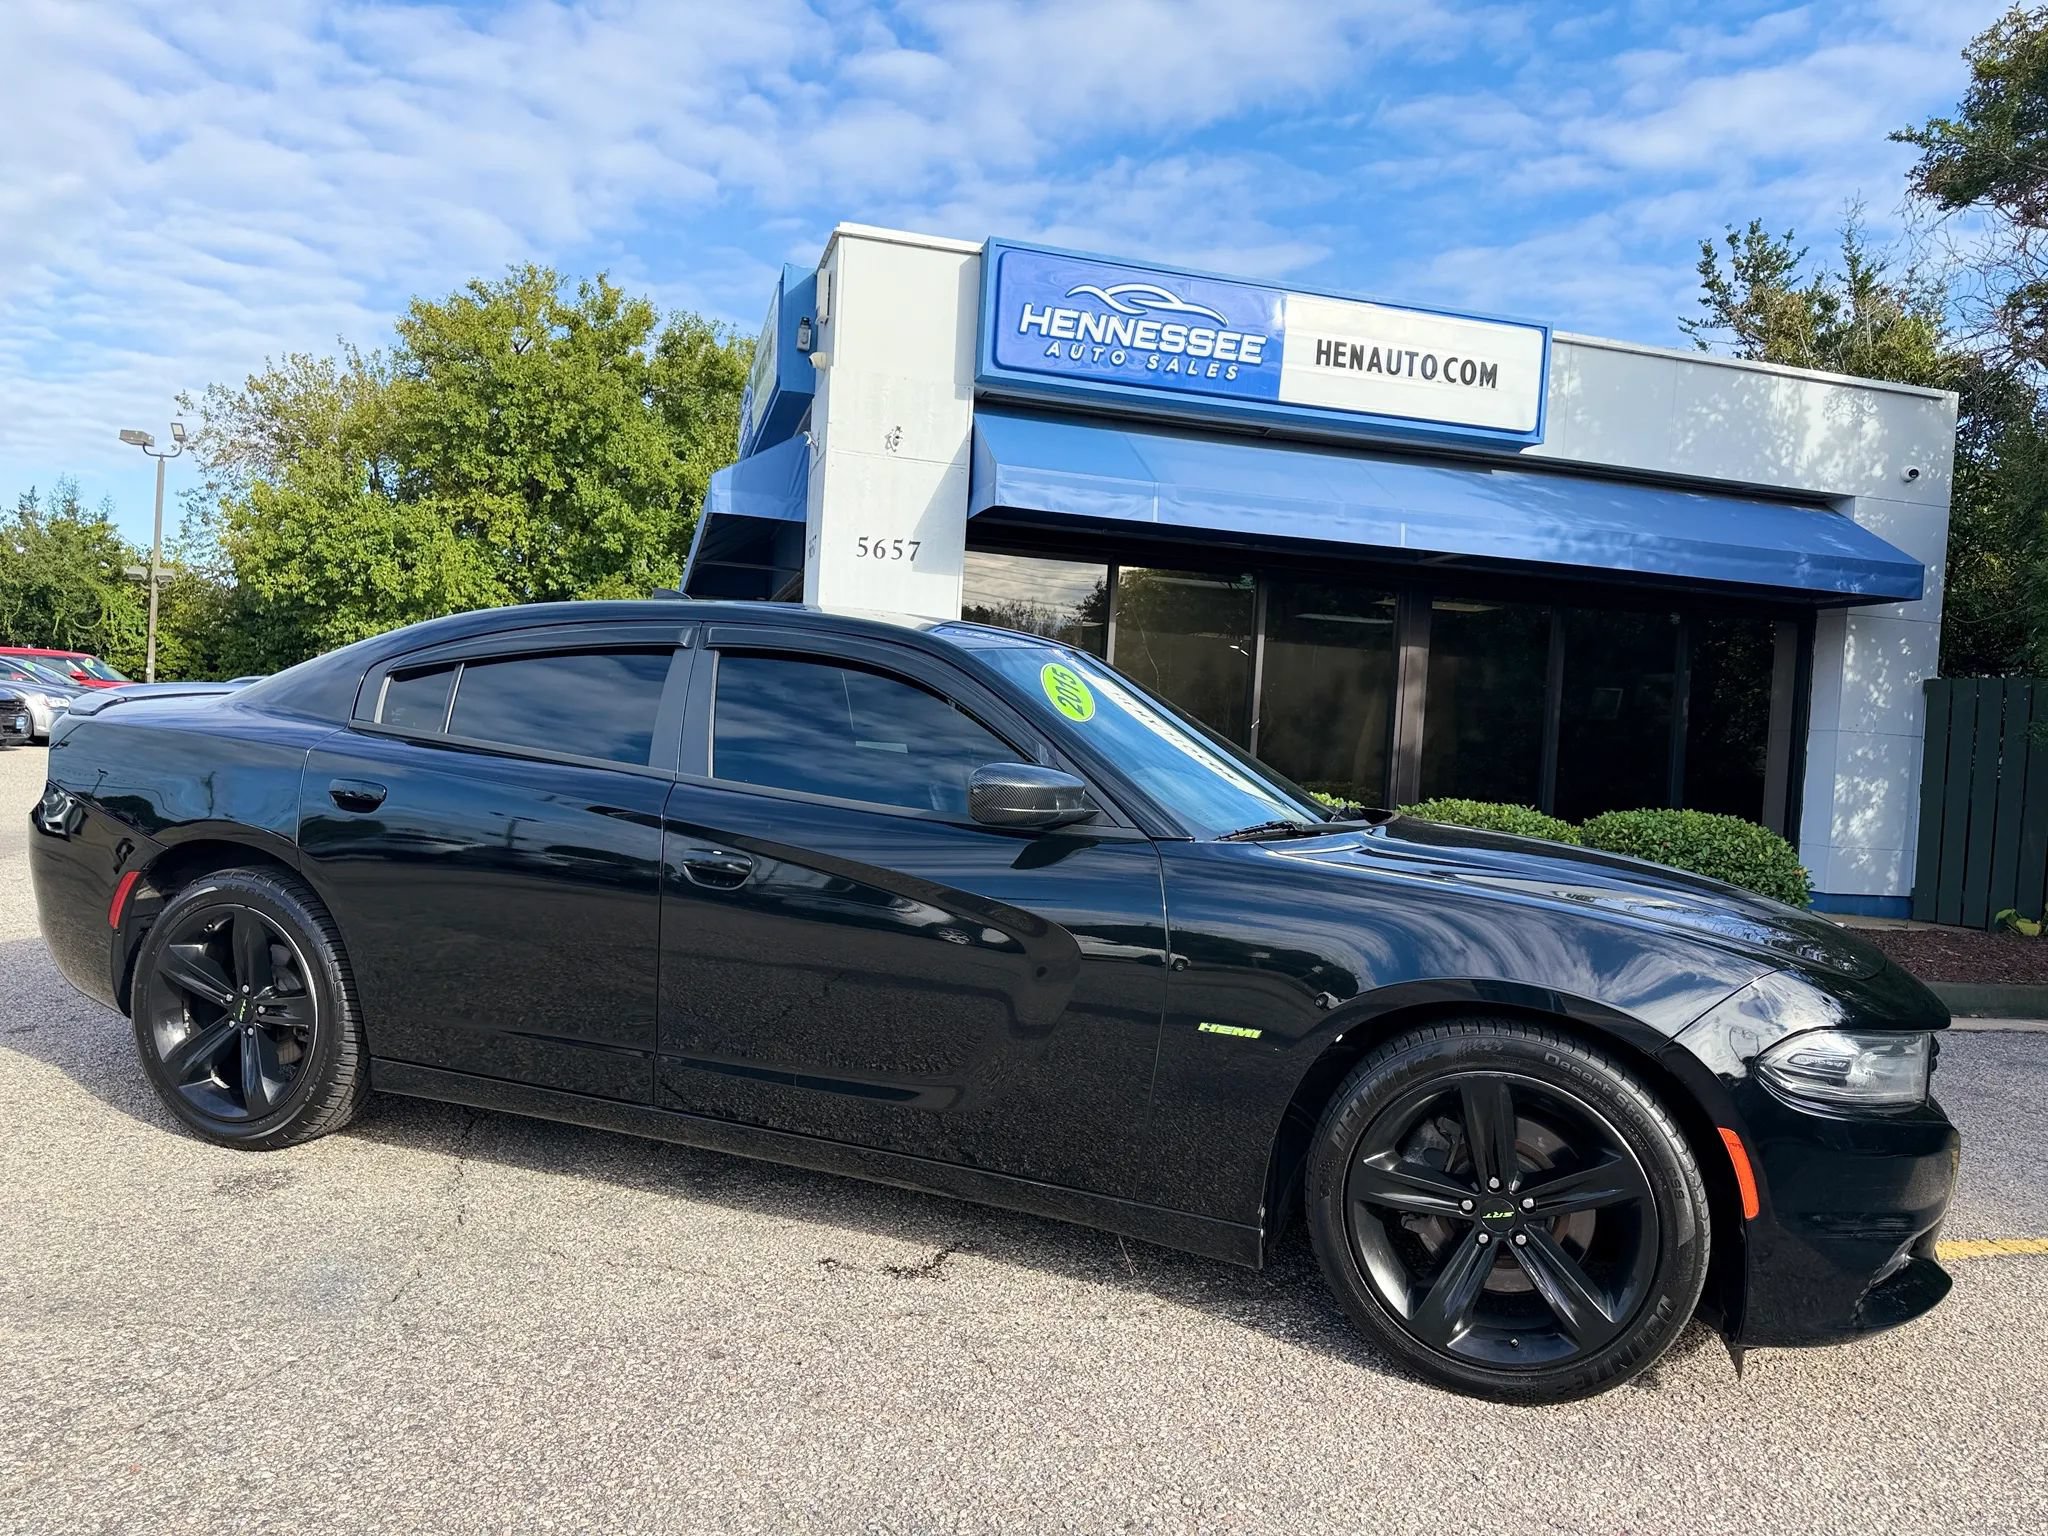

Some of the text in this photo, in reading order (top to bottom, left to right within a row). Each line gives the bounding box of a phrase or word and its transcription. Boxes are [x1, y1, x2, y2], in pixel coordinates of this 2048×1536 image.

[1019, 304, 1268, 365] HENNESSEE
[1045, 341, 1239, 380] AUTO SALES
[856, 536, 921, 562] 5657
[1051, 667, 1084, 716] 2015
[1197, 1022, 1262, 1039] HEMI
[1544, 1052, 1613, 1096] Desert
